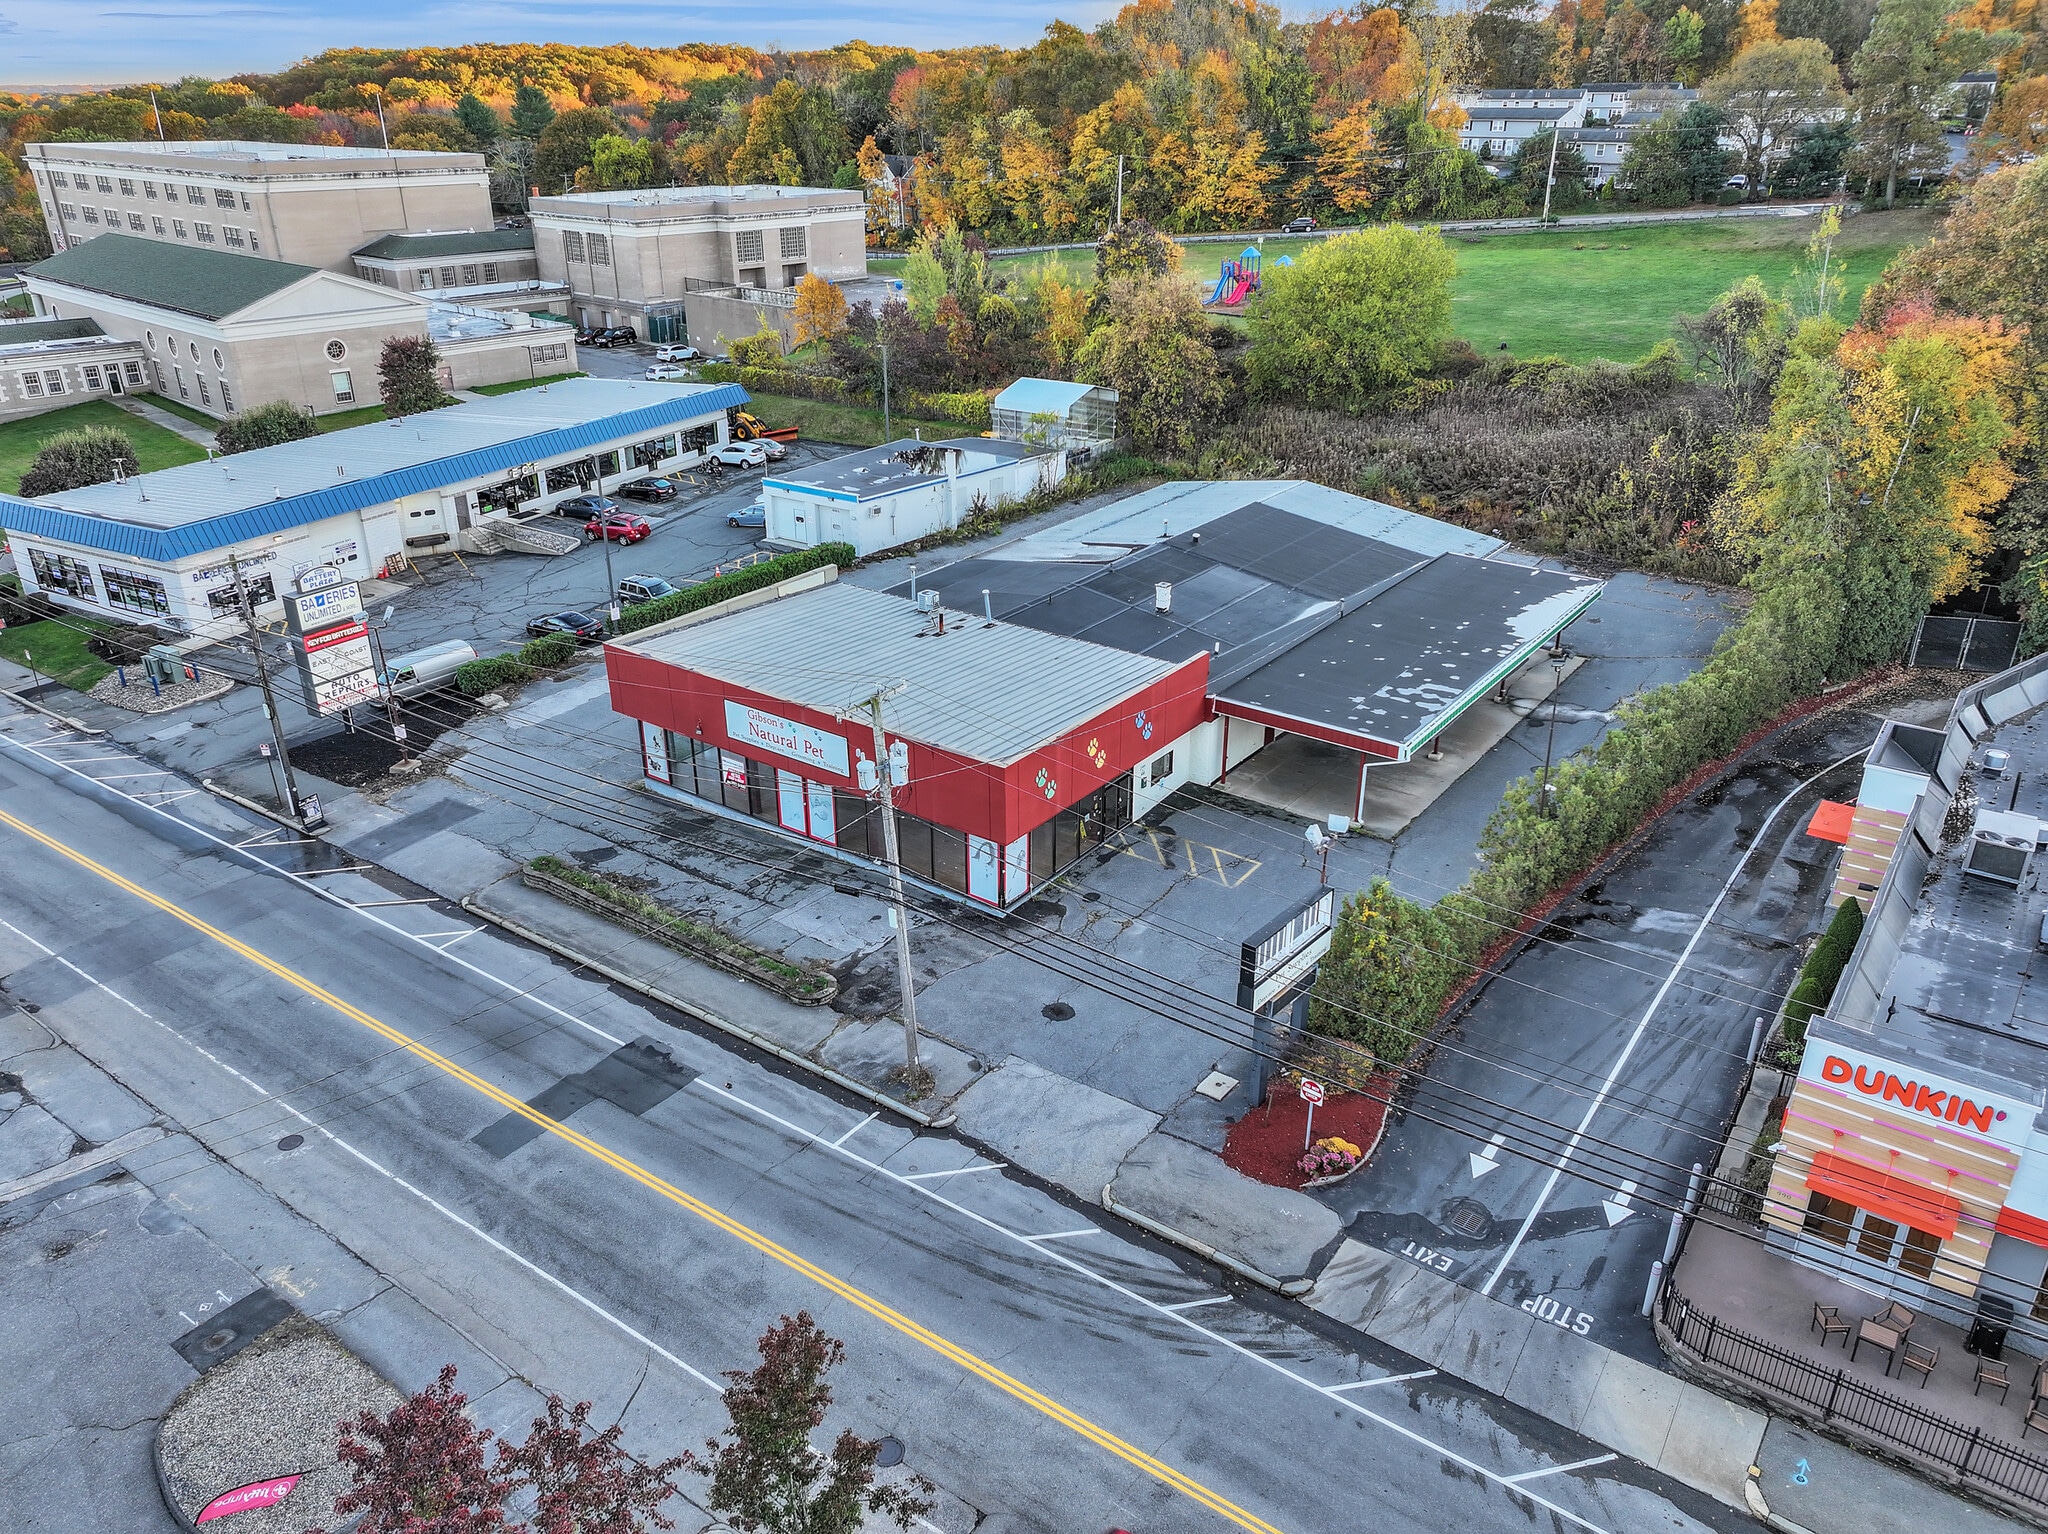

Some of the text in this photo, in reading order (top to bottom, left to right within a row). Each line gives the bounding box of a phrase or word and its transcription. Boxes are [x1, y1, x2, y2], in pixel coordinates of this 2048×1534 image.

[303, 570, 337, 584] BATTERY
[309, 577, 334, 589] PLAZA
[303, 603, 342, 623] UNLIMITED
[311, 644, 367, 668] EAST COAST
[324, 678, 370, 700] REPAIRS
[331, 673, 360, 689] AUTO
[747, 709, 784, 729] Gibson's
[748, 721, 824, 760] Natural Pet
[822, 761, 845, 774] Training
[1401, 1241, 1454, 1272] EXIT
[1521, 1294, 1595, 1335] STOP
